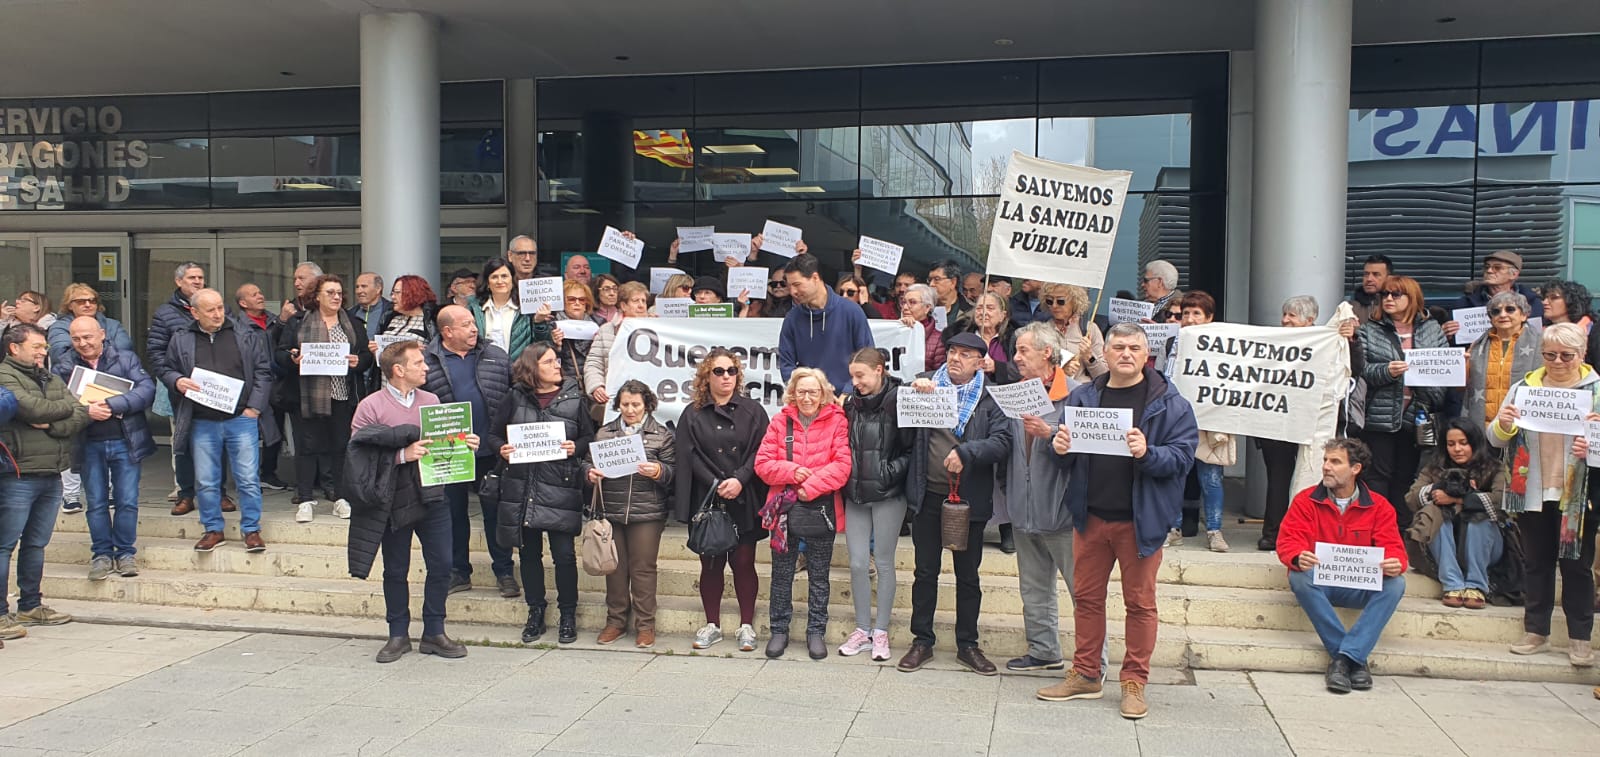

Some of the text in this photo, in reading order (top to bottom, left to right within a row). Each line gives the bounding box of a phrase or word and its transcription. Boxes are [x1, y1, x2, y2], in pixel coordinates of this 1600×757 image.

[20, 175, 130, 203] SALUD
[1015, 174, 1113, 206] SALVEMOS
[999, 200, 1114, 234] LA SANIDAD
[1009, 228, 1087, 258] PÚBLICA
[1111, 299, 1150, 310] MERECEMOS
[1111, 307, 1147, 317] ASISTENCIA
[1196, 334, 1313, 361] SALVEMOS
[1182, 357, 1315, 390] LA SANIDAD
[1196, 383, 1289, 414] PÚBLICA
[1528, 388, 1577, 400] MÉDICOS
[1524, 399, 1578, 411] PARA BAL
[1075, 409, 1119, 419] MÉDICOS
[1074, 421, 1121, 431] PARA BAL
[523, 432, 550, 440] SOMOS
[526, 449, 562, 458] PRIMERA
[598, 447, 637, 460] PARA BAL
[1333, 555, 1365, 564] SOMOS
[1318, 563, 1378, 575] HABITANTES
[1318, 573, 1377, 585] DE PRIMERA
